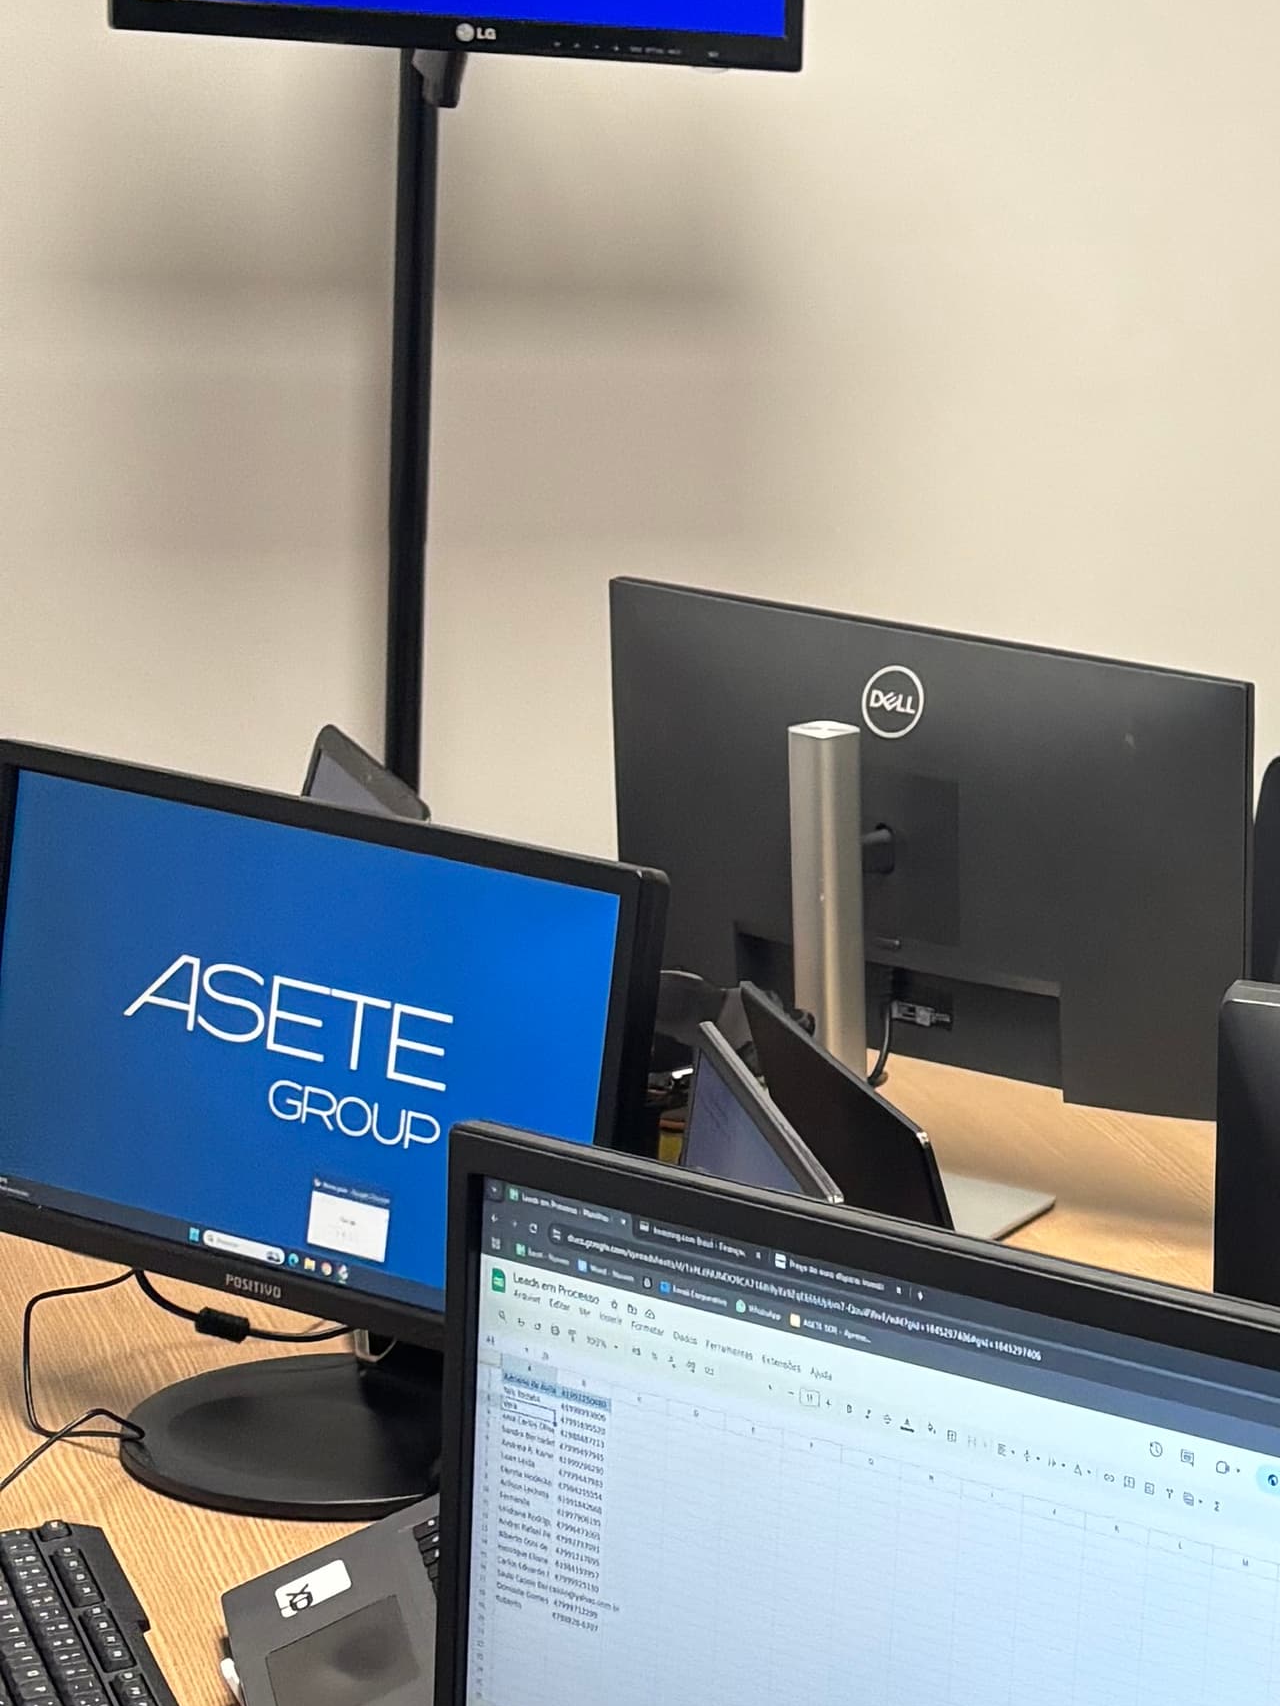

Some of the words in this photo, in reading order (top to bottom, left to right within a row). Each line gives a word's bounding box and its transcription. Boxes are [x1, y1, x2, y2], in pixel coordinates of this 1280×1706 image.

[476, 26, 497, 41] LG
[870, 689, 916, 715] DELL
[123, 954, 454, 1092] ASETE
[267, 1079, 441, 1150] GROUP
[225, 1272, 282, 1299] POSITIVO
[513, 1272, 540, 1289] Leads
[541, 1282, 556, 1293] em
[558, 1284, 600, 1305] Processo
[631, 1321, 665, 1337] Formatar
[673, 1330, 698, 1345] Dados
[705, 1339, 753, 1362] Ferramentas
[762, 1354, 802, 1374] Extensões
